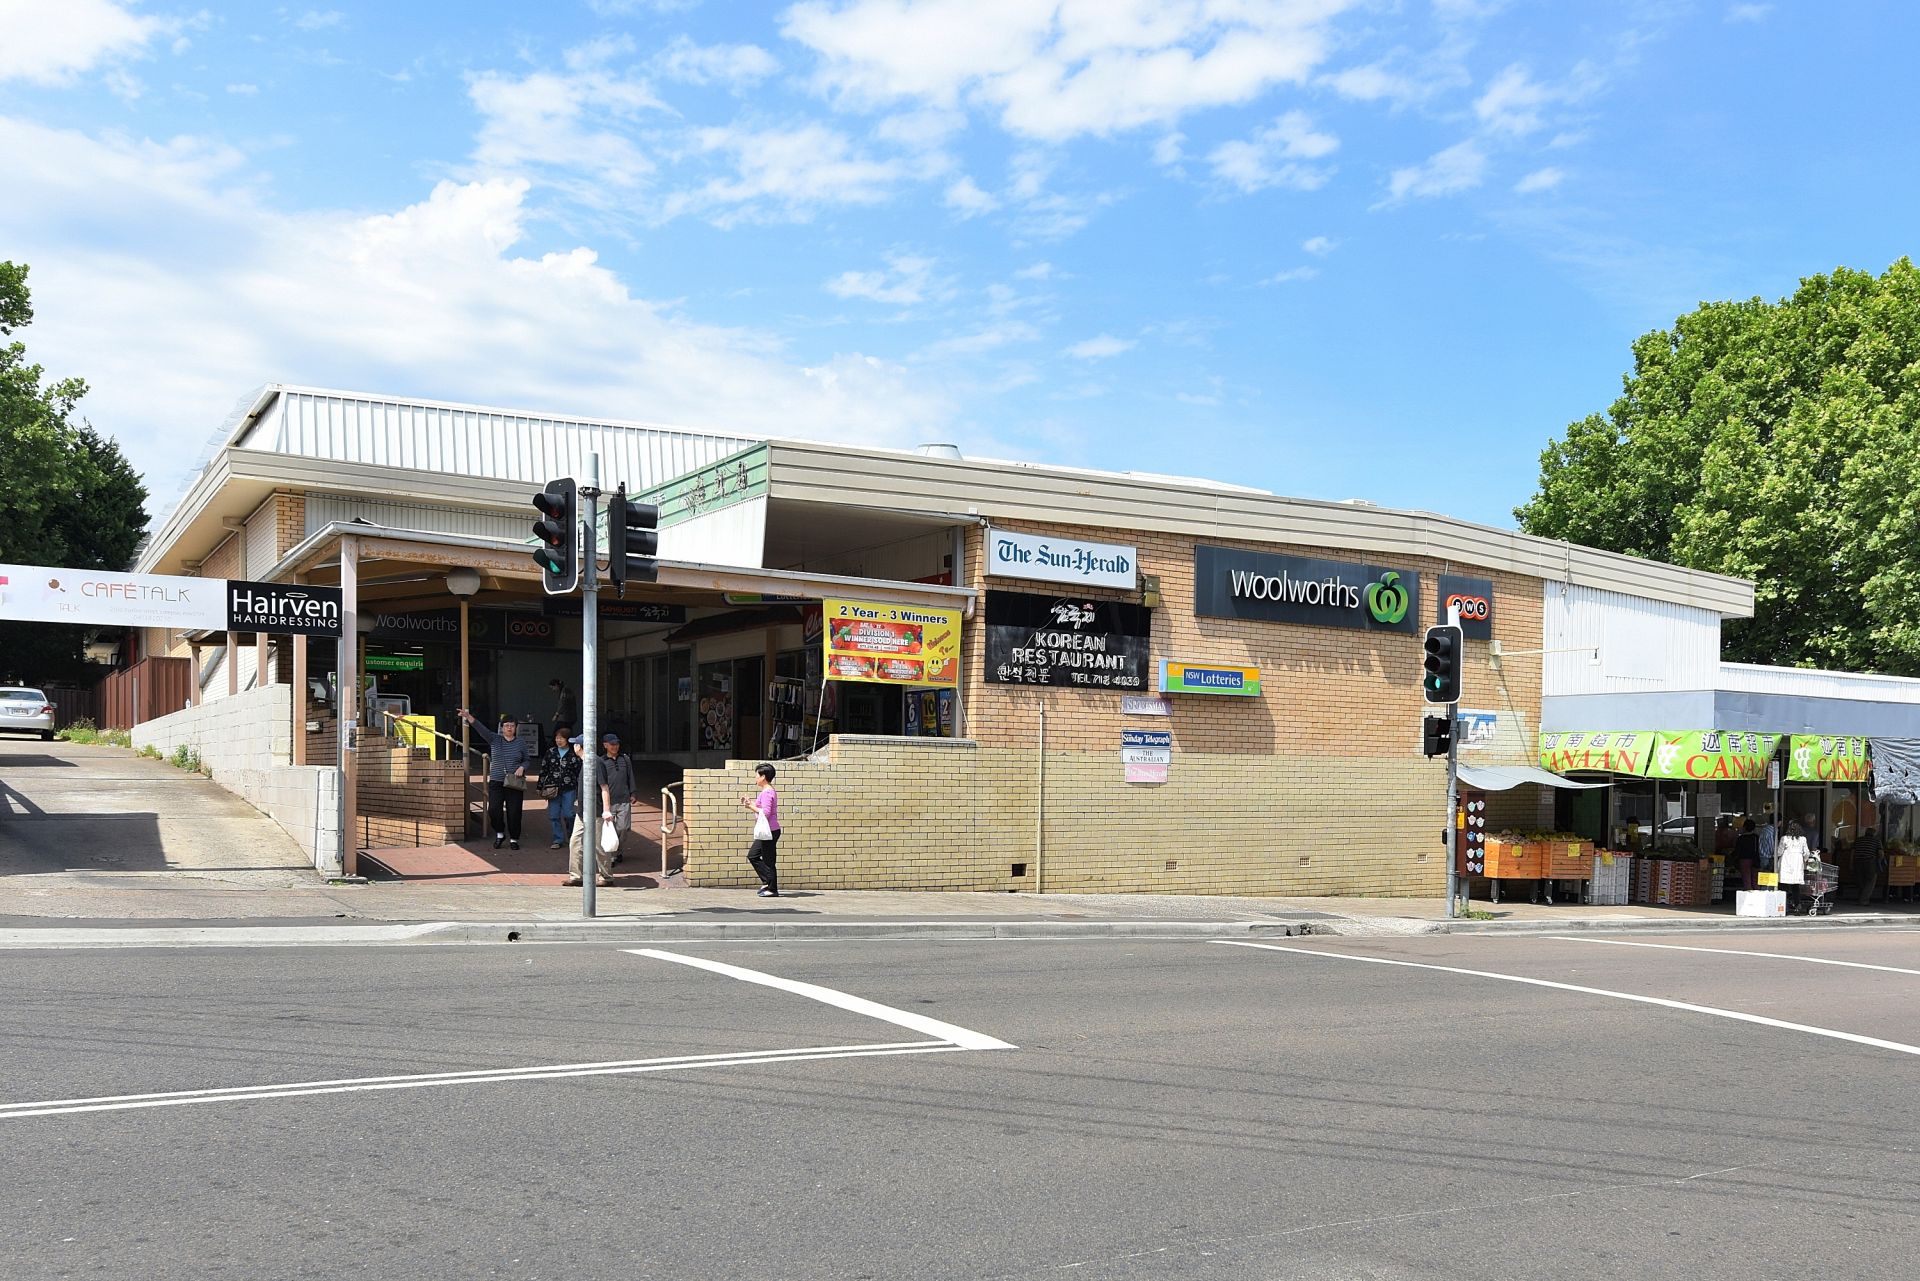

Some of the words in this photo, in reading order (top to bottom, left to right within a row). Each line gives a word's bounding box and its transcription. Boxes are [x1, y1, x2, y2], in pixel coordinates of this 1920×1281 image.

[997, 539, 1032, 565] The
[1035, 544, 1130, 575] Sun-Herald
[1231, 569, 1359, 609] Woolworths
[232, 588, 338, 618] Hairven
[233, 613, 338, 629] HAIRDRESSING
[375, 614, 458, 632] Woolworths
[839, 605, 848, 617] 2
[851, 606, 879, 620] Year
[889, 609, 898, 621] 3
[901, 610, 948, 625] Winners
[844, 635, 873, 644] WINNER
[873, 636, 891, 645] SOLD
[892, 638, 909, 646] HERE
[858, 629, 890, 638] DIVISION
[1035, 631, 1107, 652] KOREAN
[365, 659, 394, 667] ustomer
[1012, 647, 1127, 671] RESTAURANT
[1071, 672, 1091, 684] TEL
[1185, 671, 1200, 680] NSW
[1201, 672, 1241, 687] Lotteries
[1122, 734, 1144, 745] Sunday
[1144, 734, 1170, 745] Telegraph
[1129, 755, 1164, 763] AUSTRALIAN
[1685, 754, 1767, 780] CANAA
